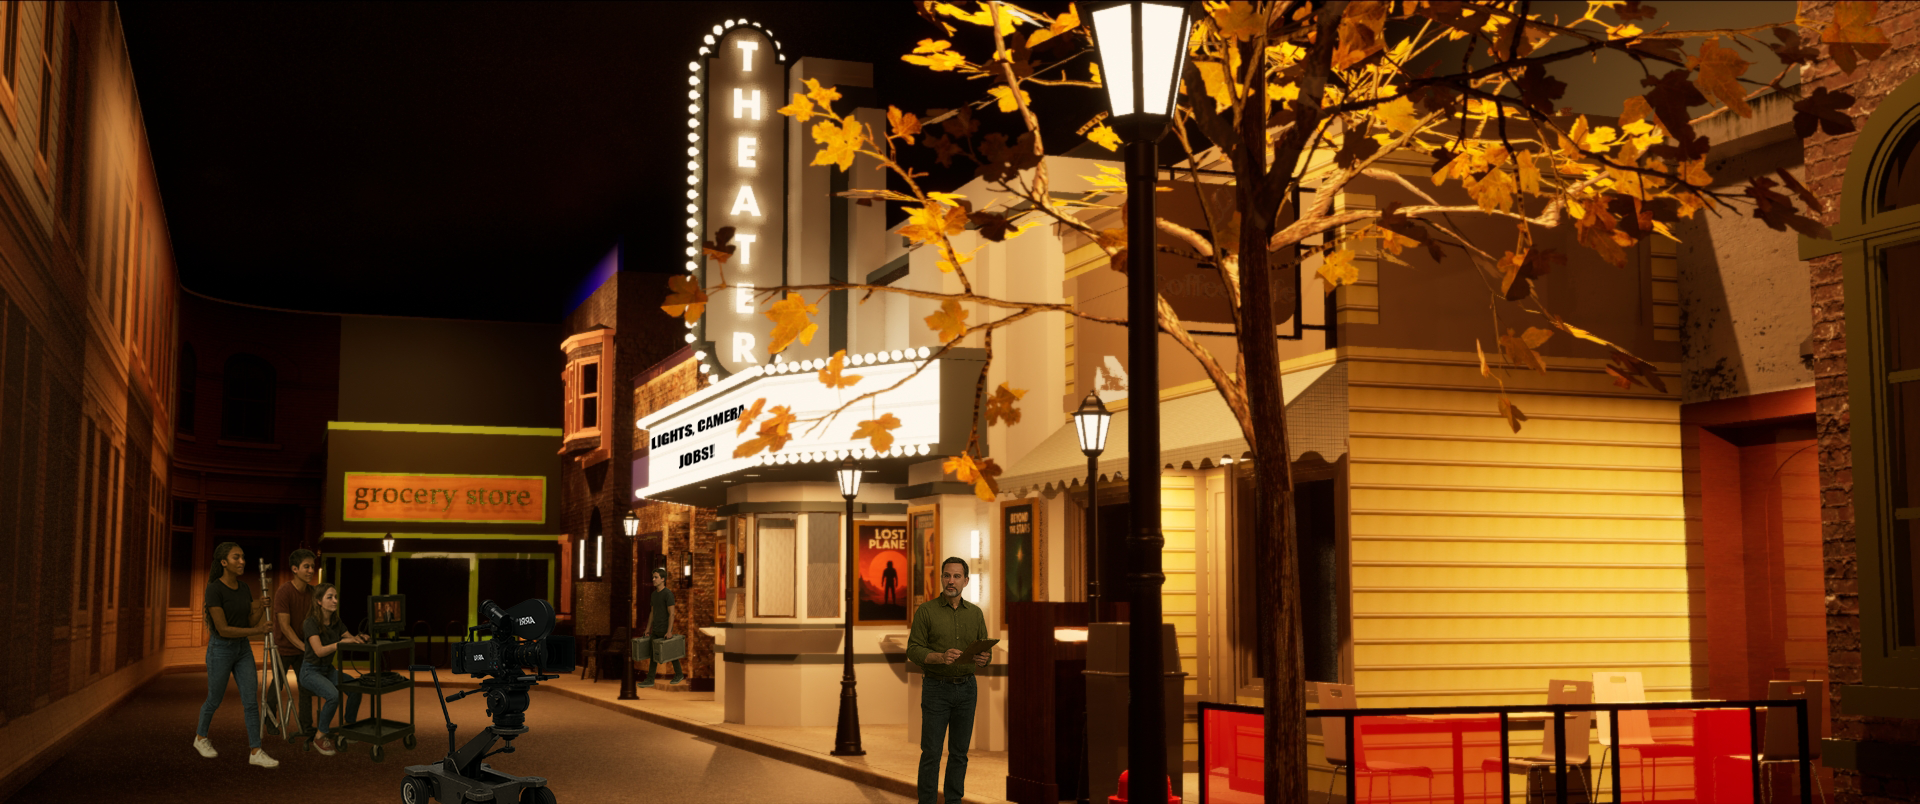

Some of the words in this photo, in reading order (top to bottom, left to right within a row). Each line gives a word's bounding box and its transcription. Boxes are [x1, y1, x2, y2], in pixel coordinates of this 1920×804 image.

[730, 40, 761, 364] THEATER
[651, 421, 695, 450] LIGHTS,
[697, 404, 745, 434] CAMERA
[679, 443, 715, 469] JOBS!
[353, 487, 458, 512] grocery
[466, 488, 531, 506] store
[1010, 511, 1029, 524] BEYOND
[875, 528, 905, 539] LOST
